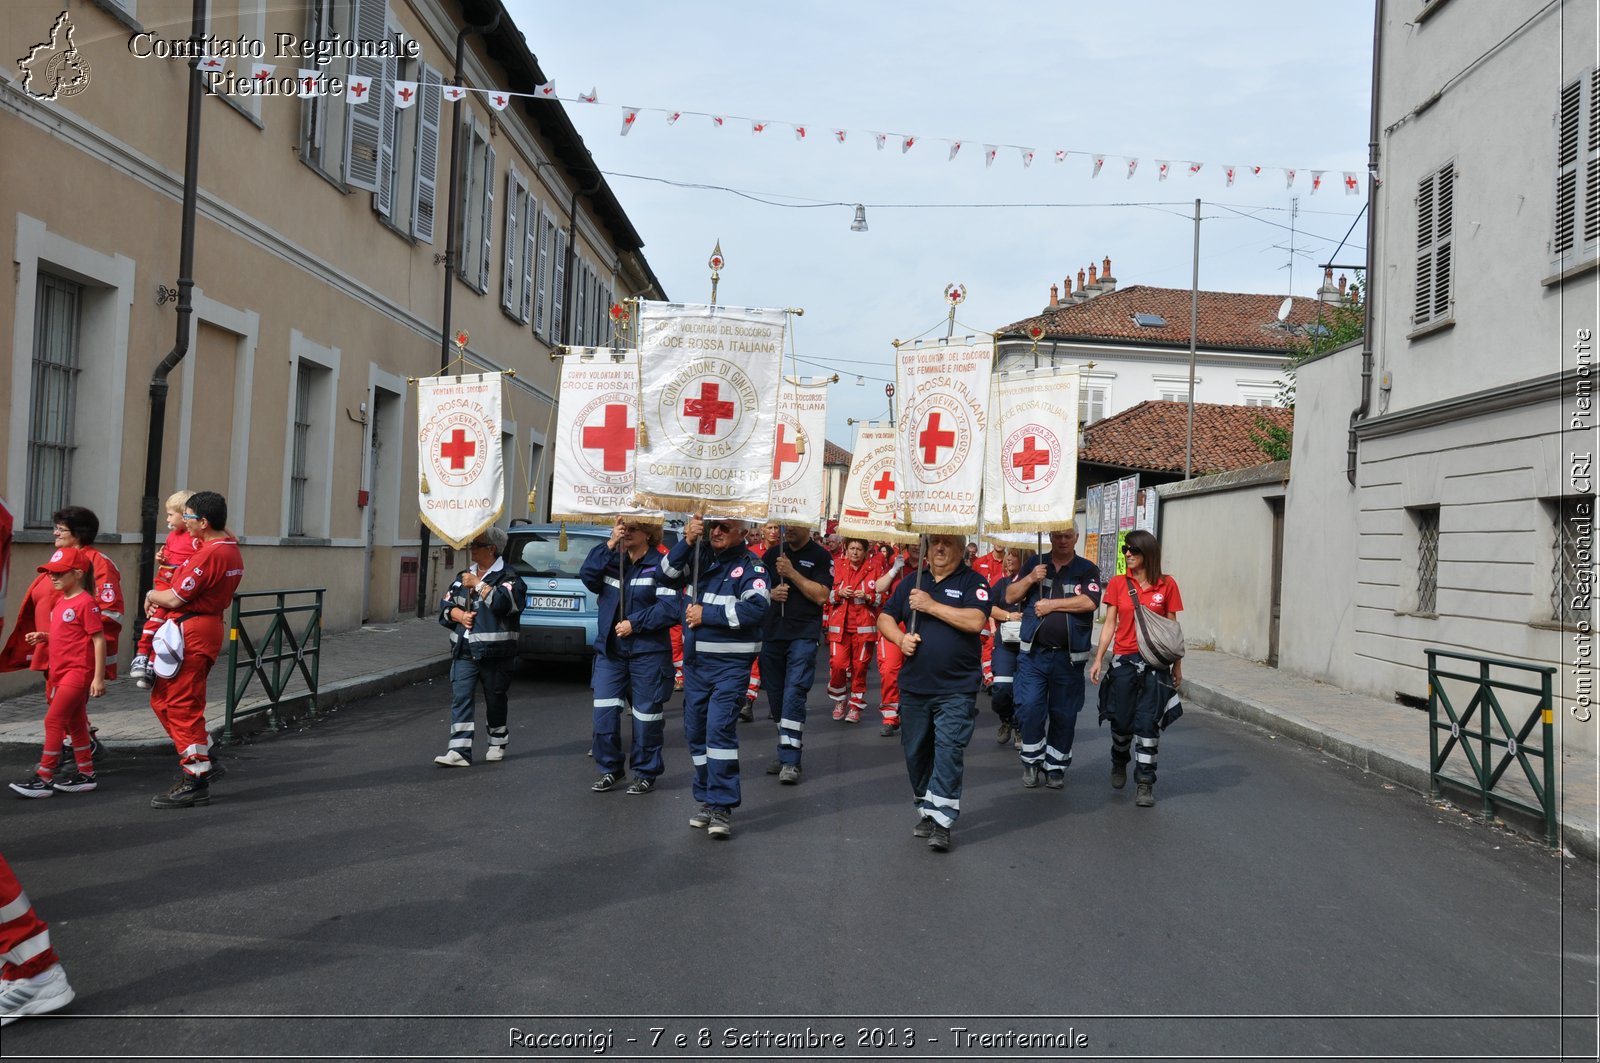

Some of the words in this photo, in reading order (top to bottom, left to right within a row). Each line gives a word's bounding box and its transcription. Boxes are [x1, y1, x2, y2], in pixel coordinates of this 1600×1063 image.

[680, 324, 717, 335] VOLONTARI
[720, 326, 733, 336] DEL
[734, 327, 772, 338] SOCCORSO
[688, 338, 724, 351] ROSSA
[729, 341, 775, 353] ITALIANA
[948, 352, 960, 361] DEL
[623, 371, 635, 380] DEL
[562, 381, 594, 390] CROCE
[597, 382, 629, 391] ROSSA
[662, 361, 716, 407] CONVENZIONE
[720, 363, 732, 377] DI
[731, 371, 756, 412] GINEVRA
[784, 393, 794, 401] DEL
[437, 398, 470, 414] ROSSA
[575, 393, 620, 427] CONVENZIONE
[916, 376, 952, 395] ROSSA
[952, 380, 987, 433] ITALIANA
[1016, 400, 1040, 414] ROSSA
[851, 452, 873, 476] CROCE
[649, 463, 702, 479] COMITATO
[706, 467, 746, 481] LOCALE
[675, 481, 736, 497] MONESIGLIO
[927, 490, 963, 501] LOCALE
[427, 498, 491, 510] SAVIGLIANO
[843, 516, 875, 526] COMITATO
[876, 519, 883, 527] DI
[532, 597, 543, 607] DC
[546, 598, 574, 608] 064MT
